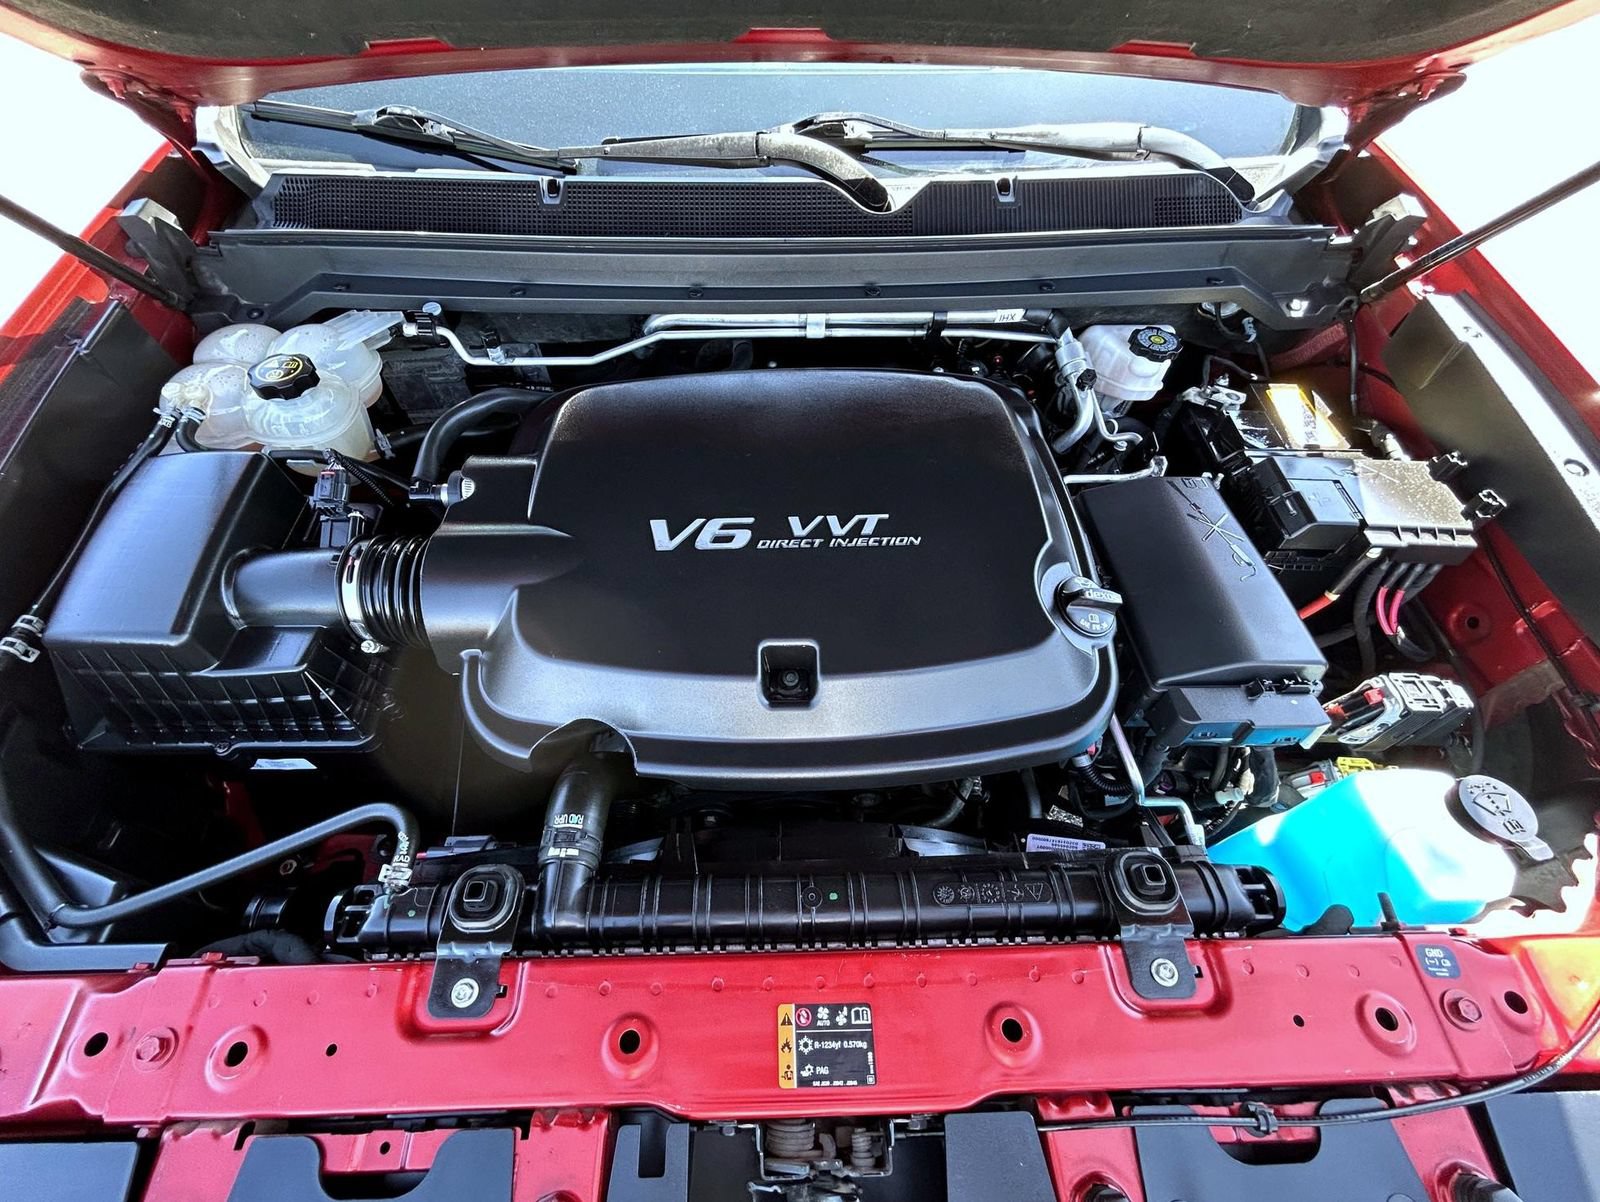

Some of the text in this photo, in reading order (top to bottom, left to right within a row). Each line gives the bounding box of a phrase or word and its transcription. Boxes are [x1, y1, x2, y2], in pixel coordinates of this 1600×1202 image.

[649, 513, 890, 551] V6 VVT
[756, 536, 921, 549] DIRECT INJECTION
[393, 854, 411, 863] RAD
[814, 1040, 841, 1050] R-1234yf
[816, 1065, 830, 1075] PAG
